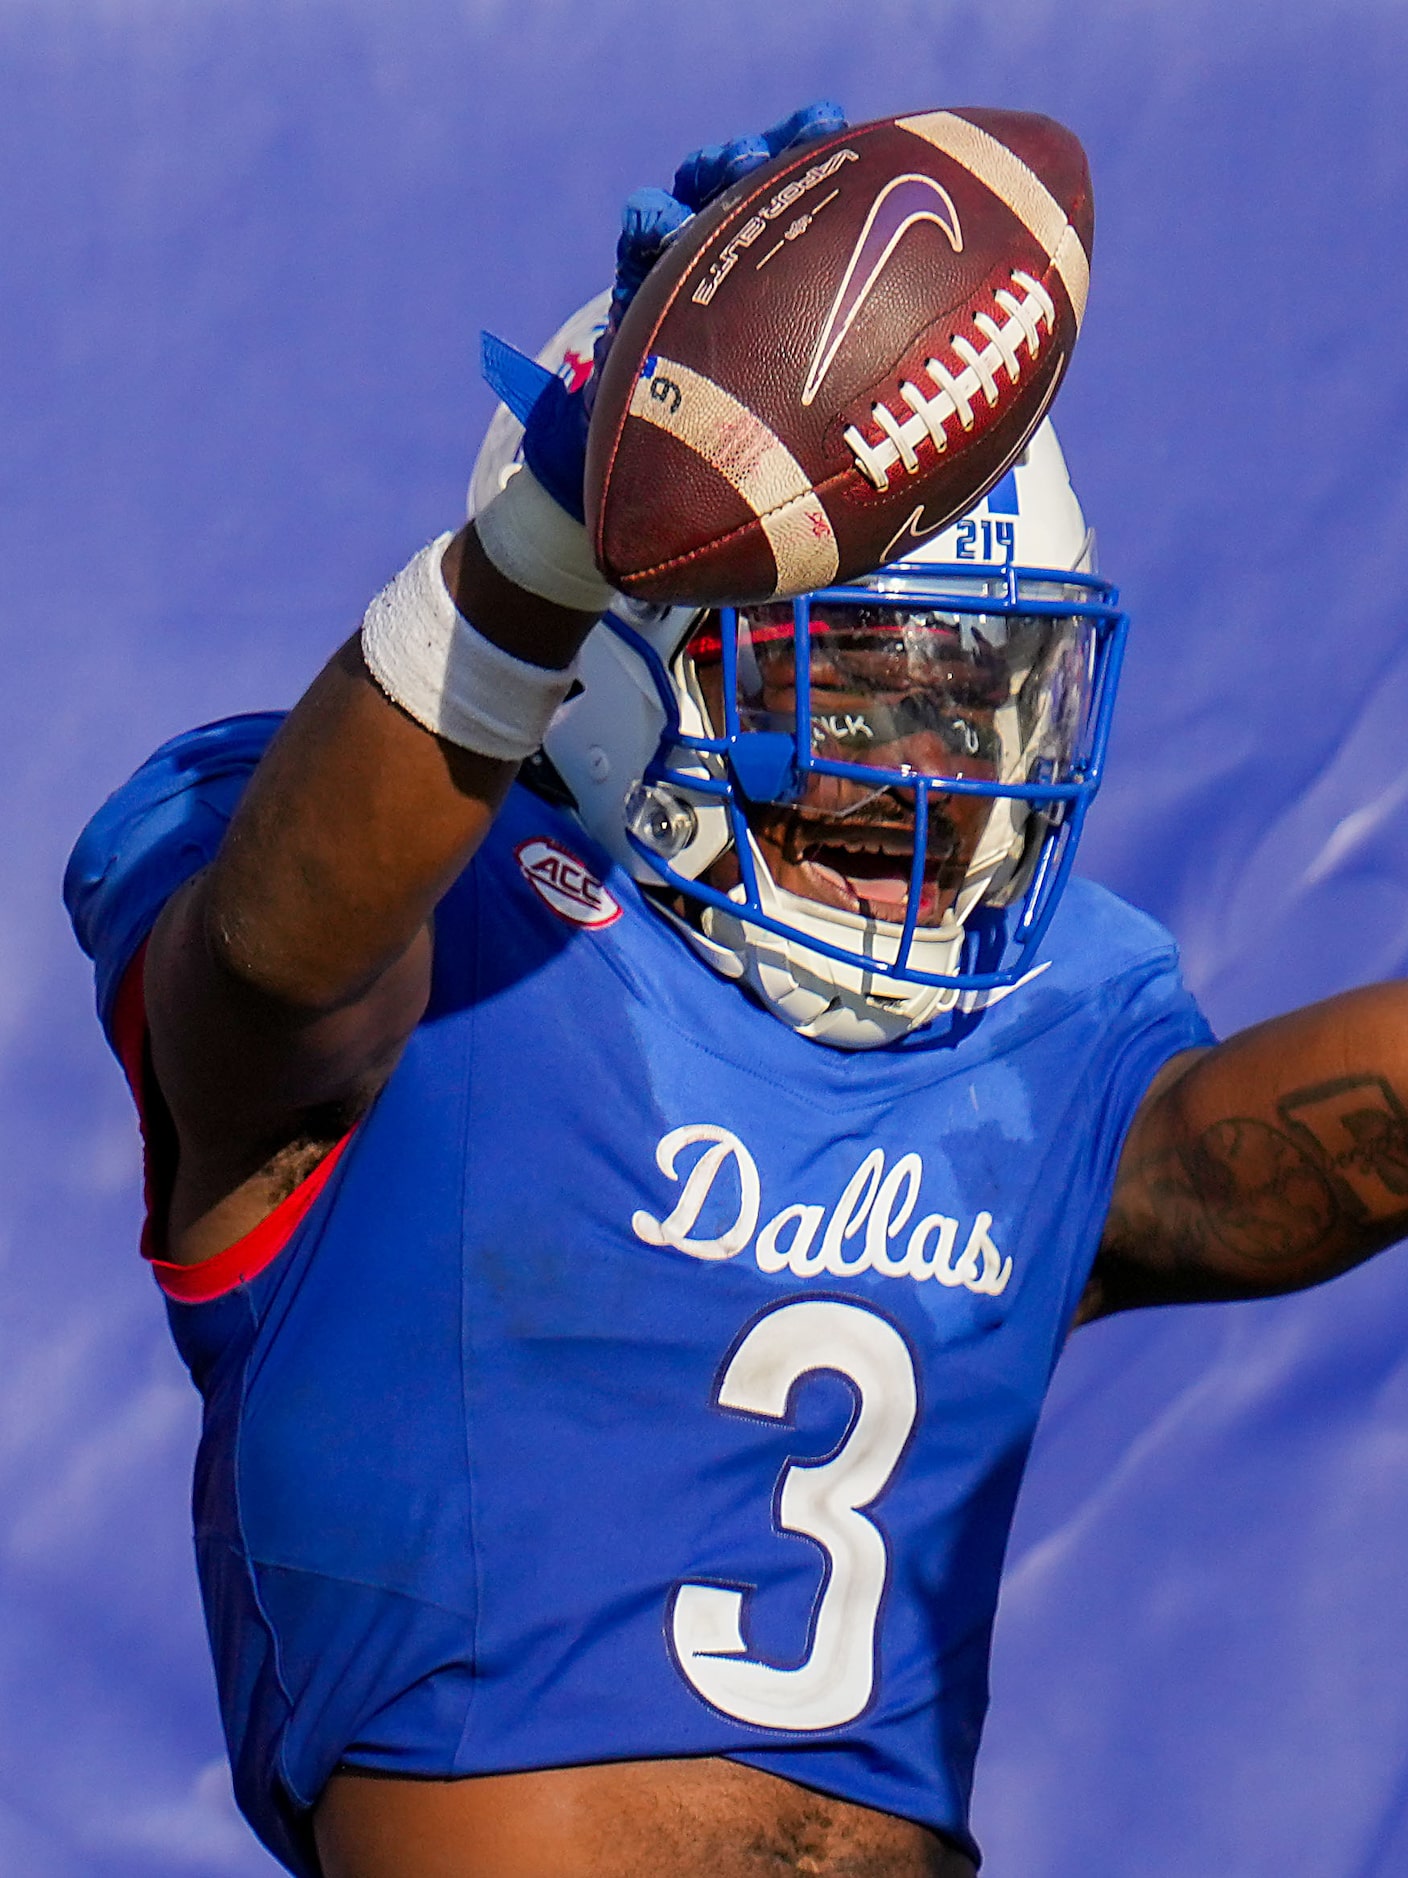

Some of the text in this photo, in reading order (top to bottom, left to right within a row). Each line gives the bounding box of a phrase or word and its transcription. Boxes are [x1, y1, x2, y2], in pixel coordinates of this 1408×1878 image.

[956, 519, 1014, 562] 214
[530, 856, 602, 905] ACC
[631, 1123, 1013, 1296] Dallas
[668, 1293, 922, 1734] 3
